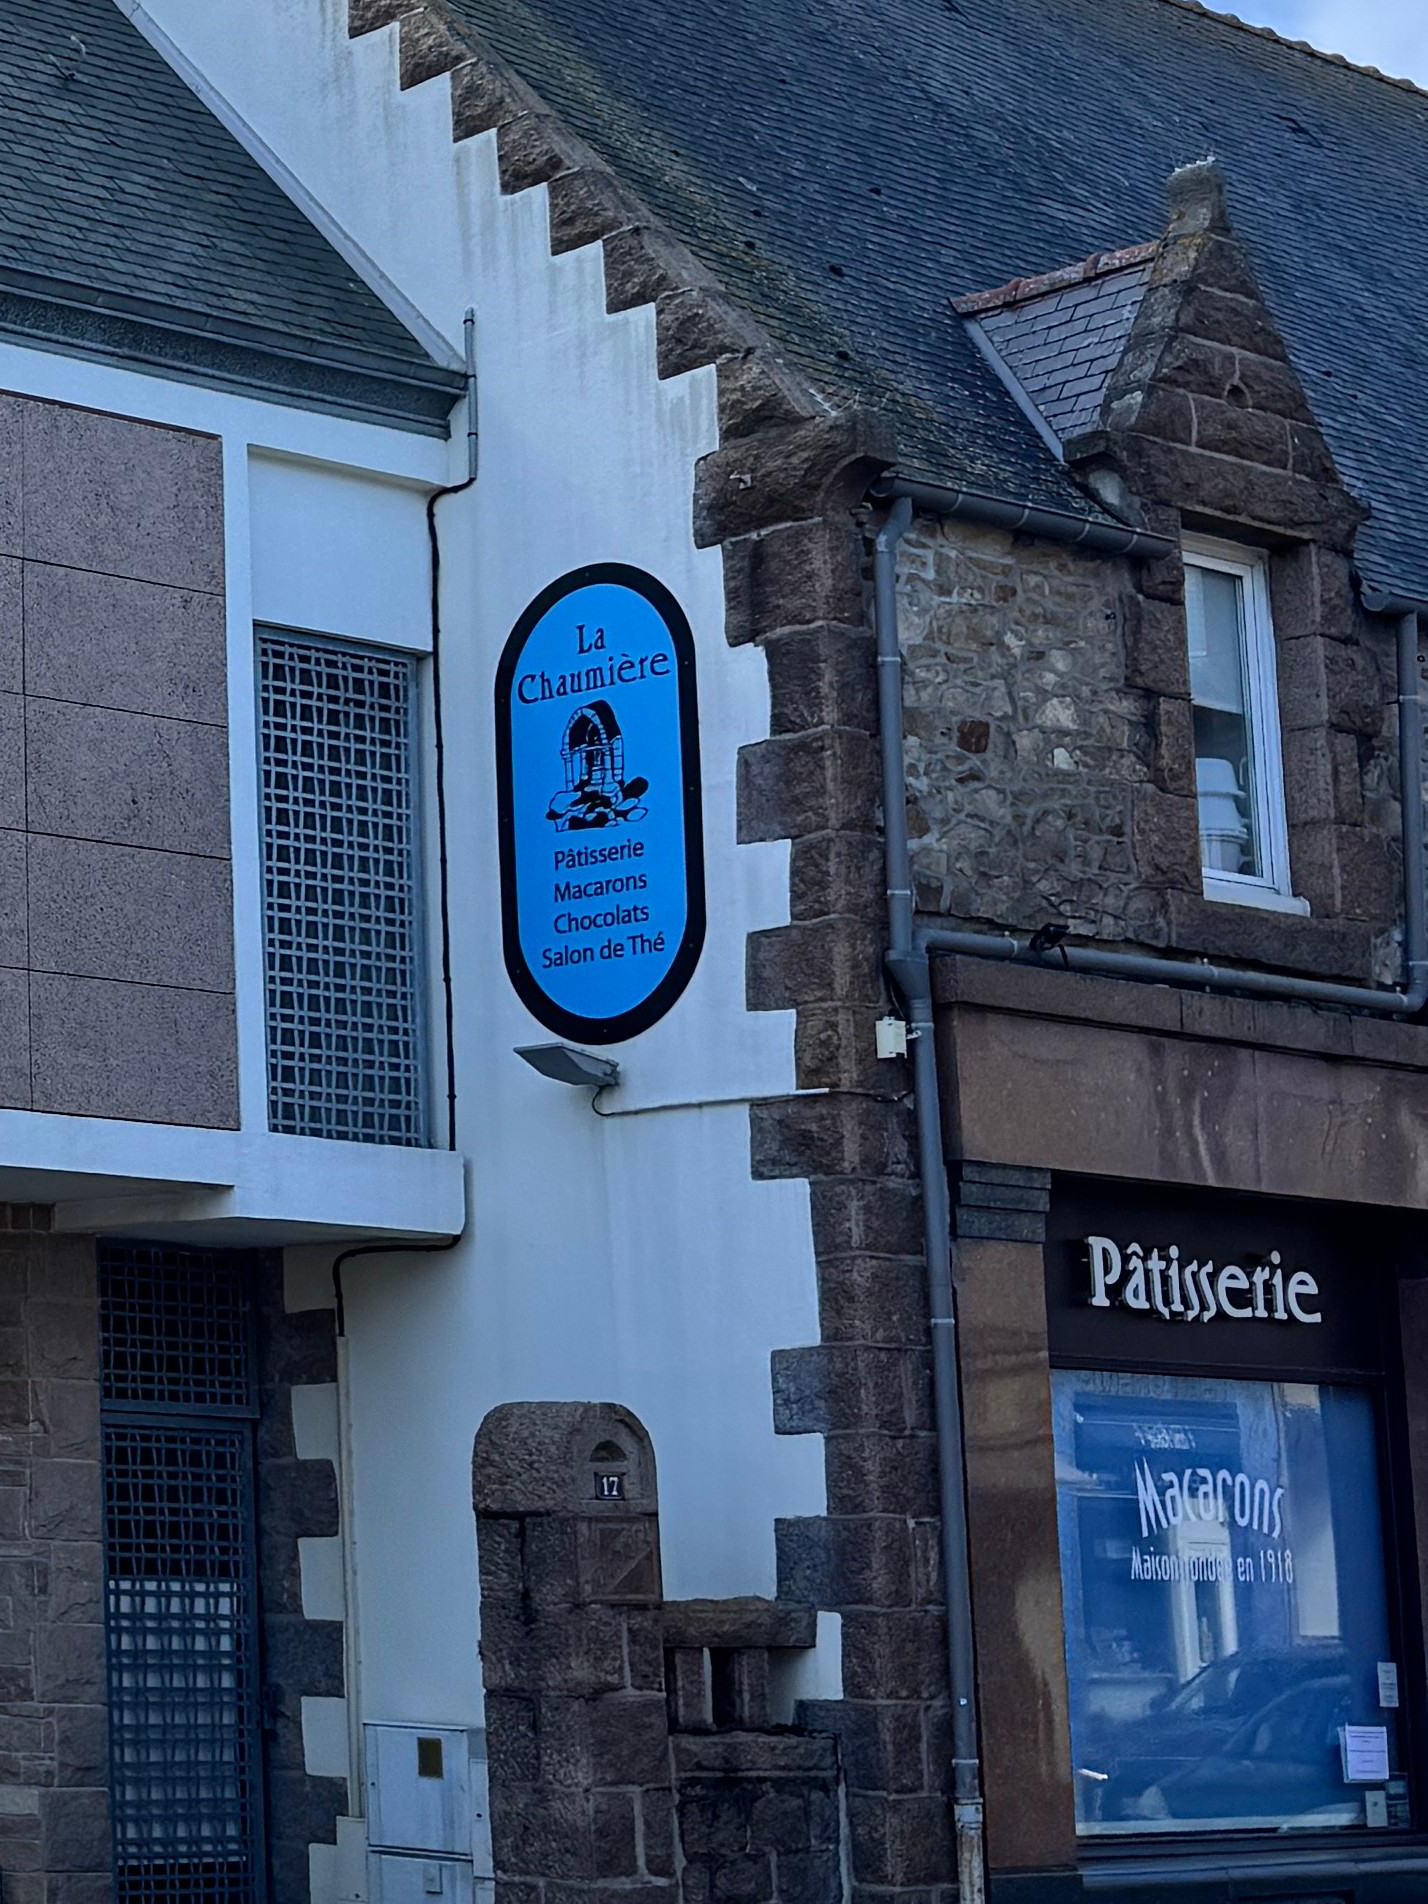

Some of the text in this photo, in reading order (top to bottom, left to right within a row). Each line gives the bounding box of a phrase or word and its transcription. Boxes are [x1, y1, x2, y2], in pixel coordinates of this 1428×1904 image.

[576, 623, 606, 655] La
[517, 652, 671, 705] Chaumière
[554, 838, 645, 871] Pâtisserie
[554, 873, 648, 903] Macarons
[553, 904, 649, 934] Chocolats
[542, 930, 665, 969] Salon de Thé
[1088, 1235, 1321, 1324] Pâtisserie
[602, 1476, 619, 1496] 17
[1134, 1455, 1286, 1540] Macarons
[1130, 1544, 1179, 1581] Maison
[1237, 1556, 1255, 1583] en
[1260, 1548, 1294, 1584] 1918
